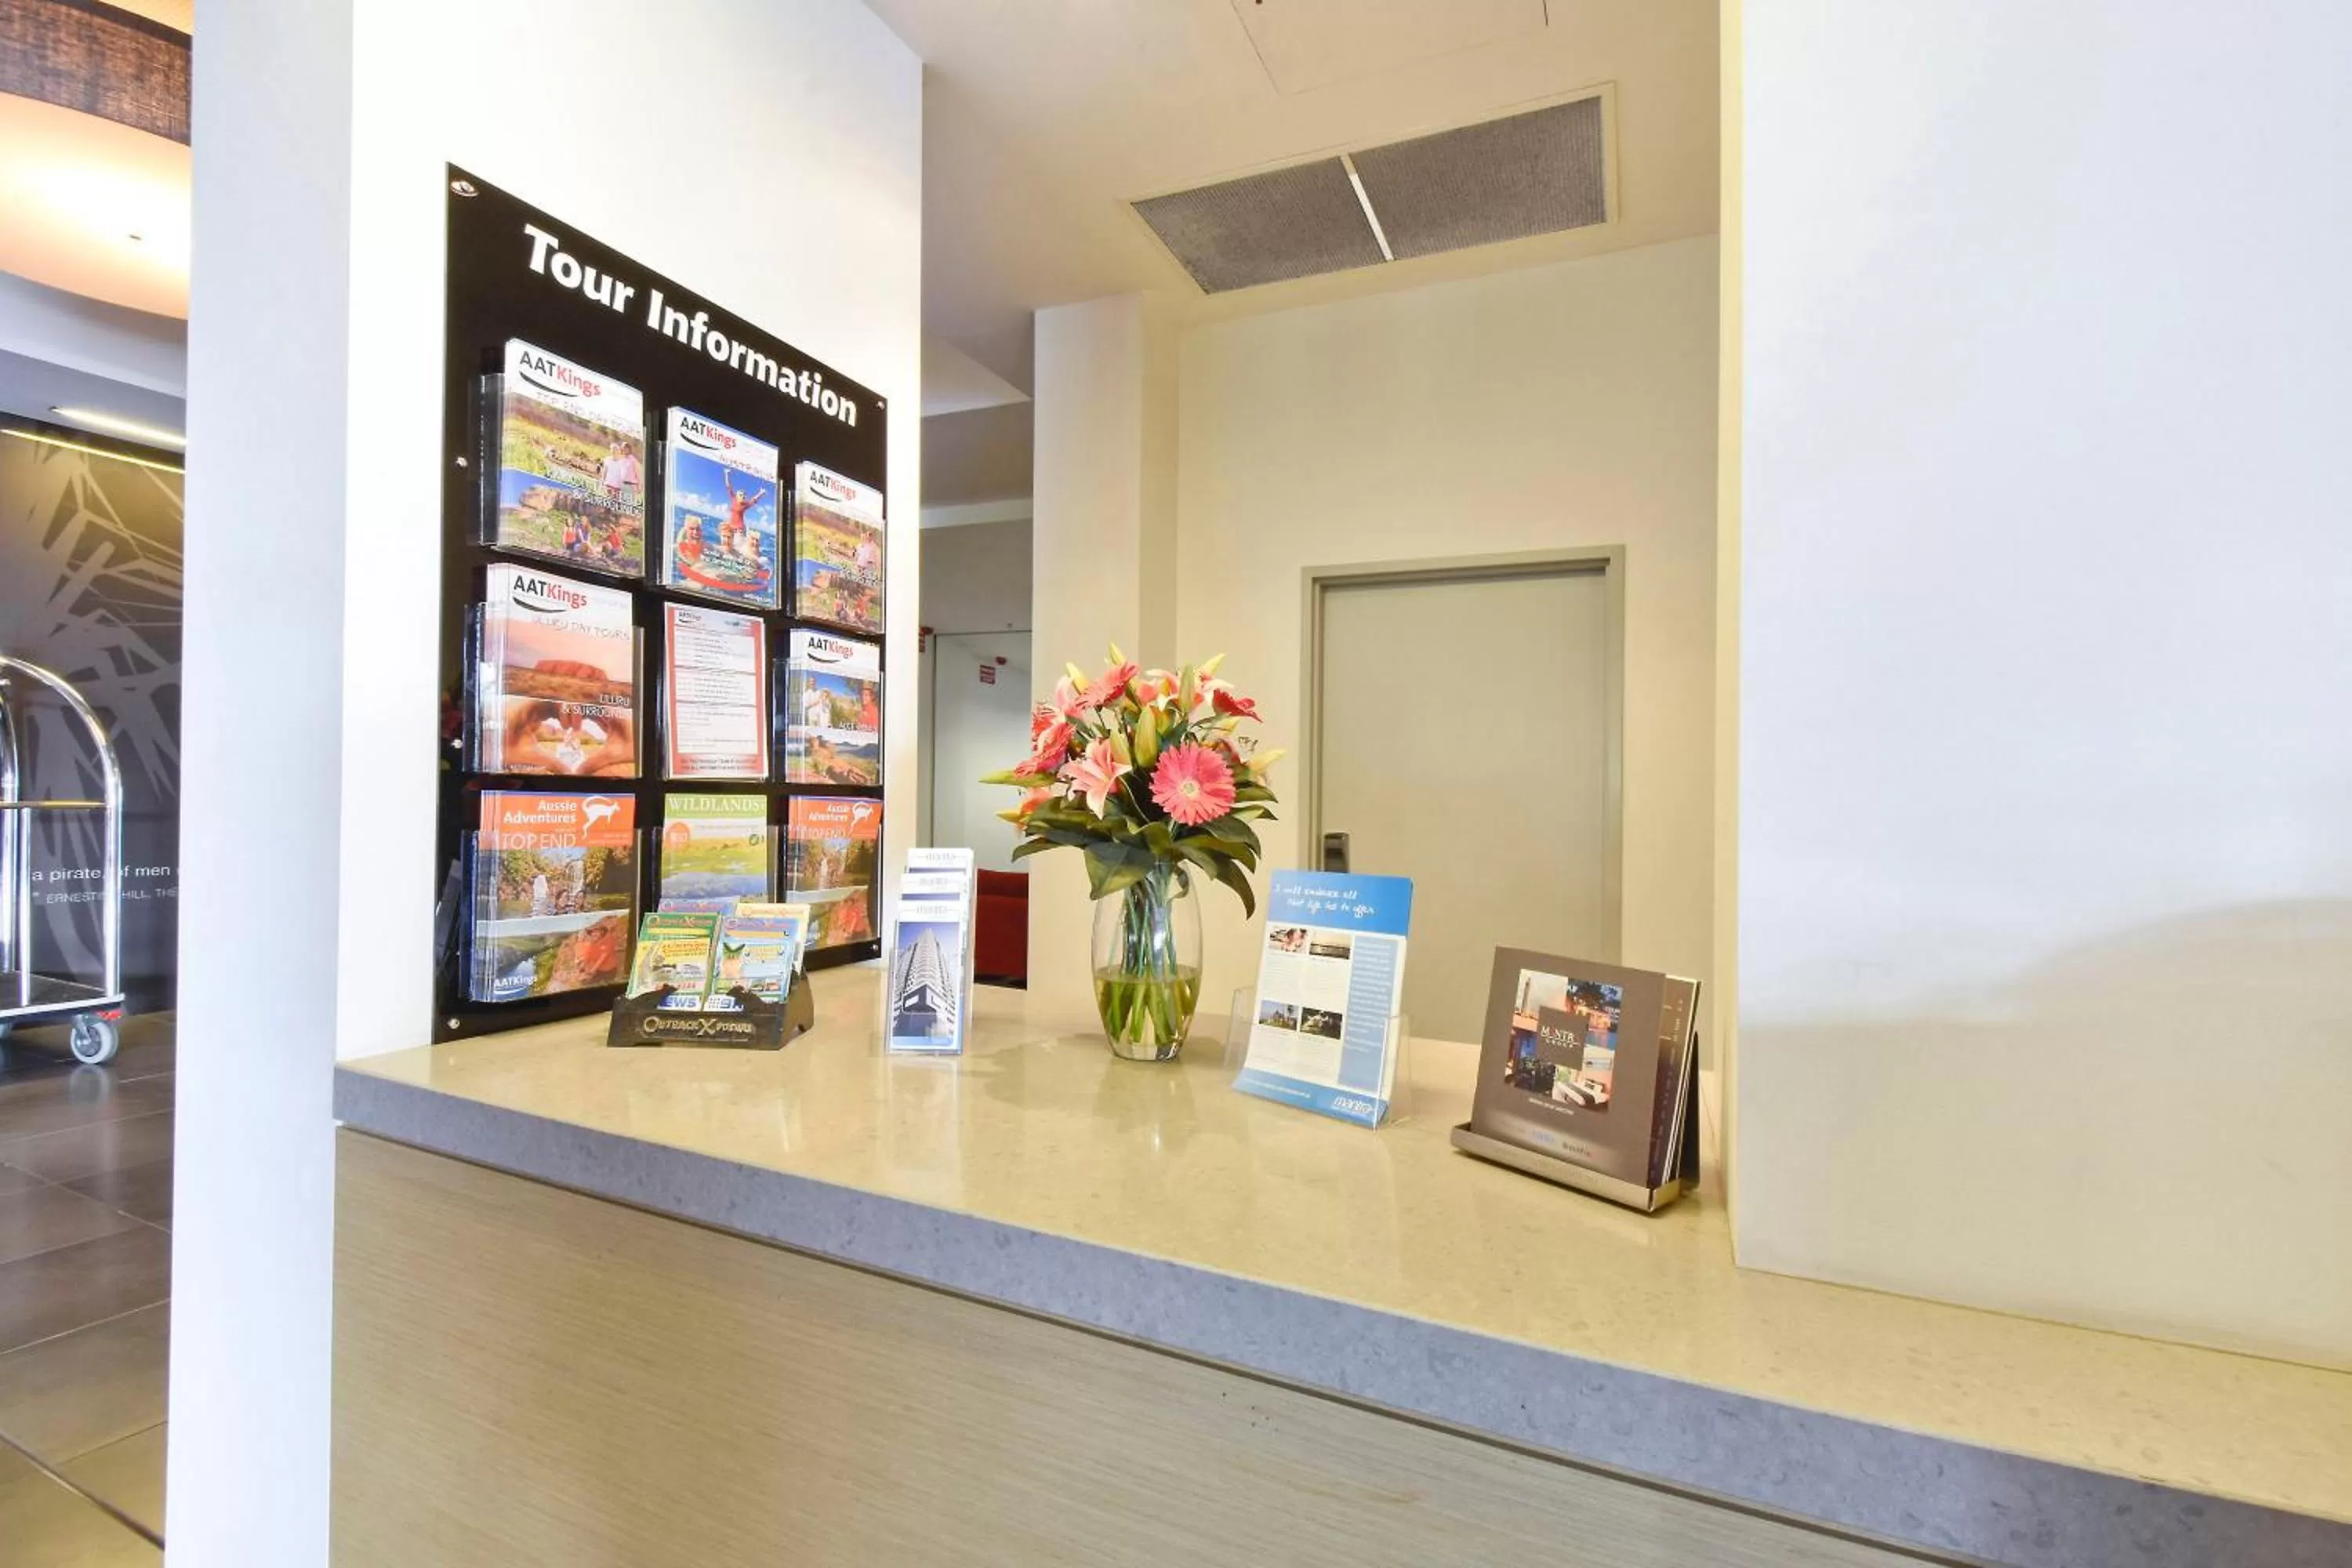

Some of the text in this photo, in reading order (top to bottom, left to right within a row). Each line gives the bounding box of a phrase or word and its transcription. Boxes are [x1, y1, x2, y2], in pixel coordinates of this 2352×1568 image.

[524, 223, 858, 426] Tour Information
[520, 350, 601, 397] AATKings
[680, 416, 737, 449] AATKings
[810, 470, 857, 502] AATKings
[514, 574, 588, 609] AATKings
[808, 636, 854, 659] AATKings
[538, 799, 578, 811] Aussie
[668, 797, 760, 811] WILDLANDS
[503, 810, 578, 824] Adventures
[501, 833, 537, 851] TOP
[540, 833, 577, 850] END
[135, 866, 171, 877] men
